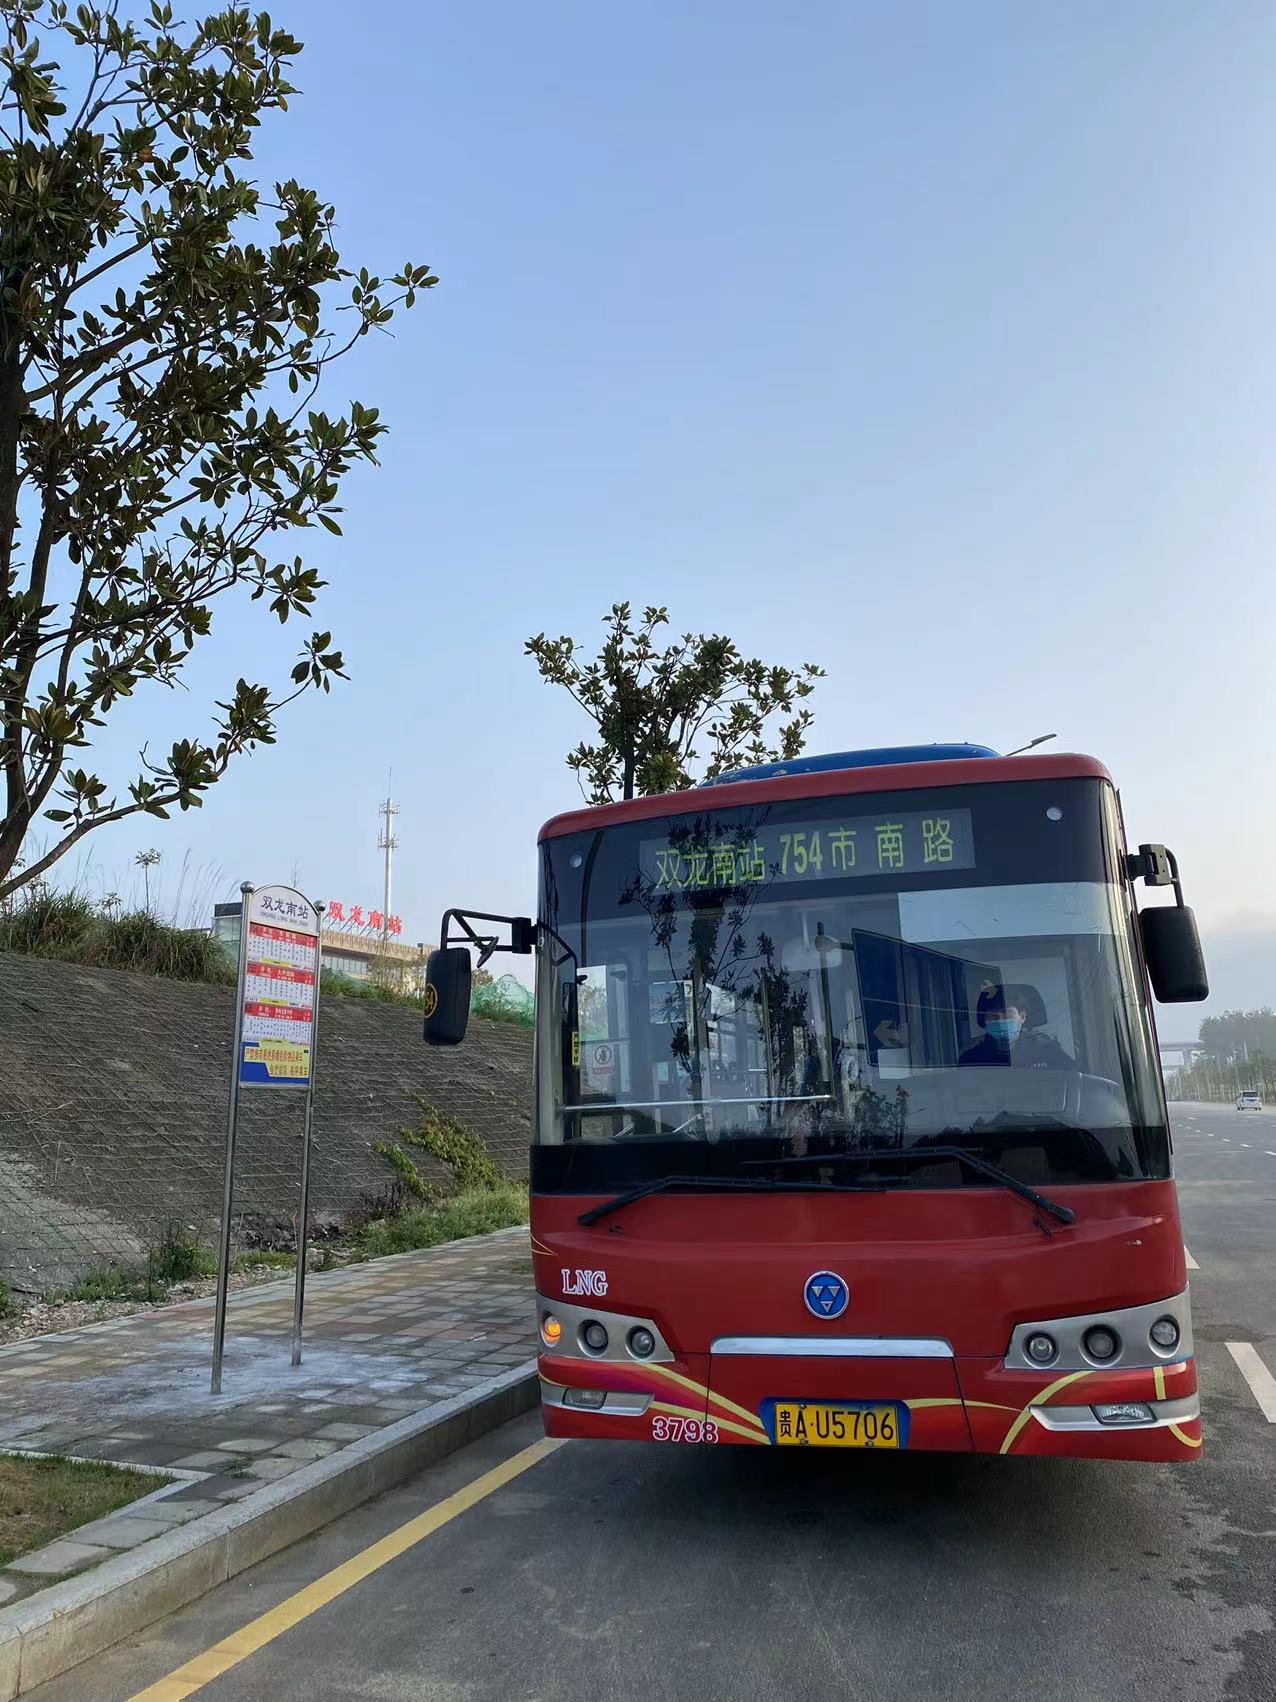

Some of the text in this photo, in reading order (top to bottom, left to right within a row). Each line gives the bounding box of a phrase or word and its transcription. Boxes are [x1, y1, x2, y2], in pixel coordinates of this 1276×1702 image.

[655, 817, 954, 889] 双龙南站 754 市南路
[260, 895, 309, 920] 双龙南站
[328, 900, 402, 935] 双龙南站
[561, 1269, 608, 1296] LNG
[652, 1416, 719, 1444] 3798
